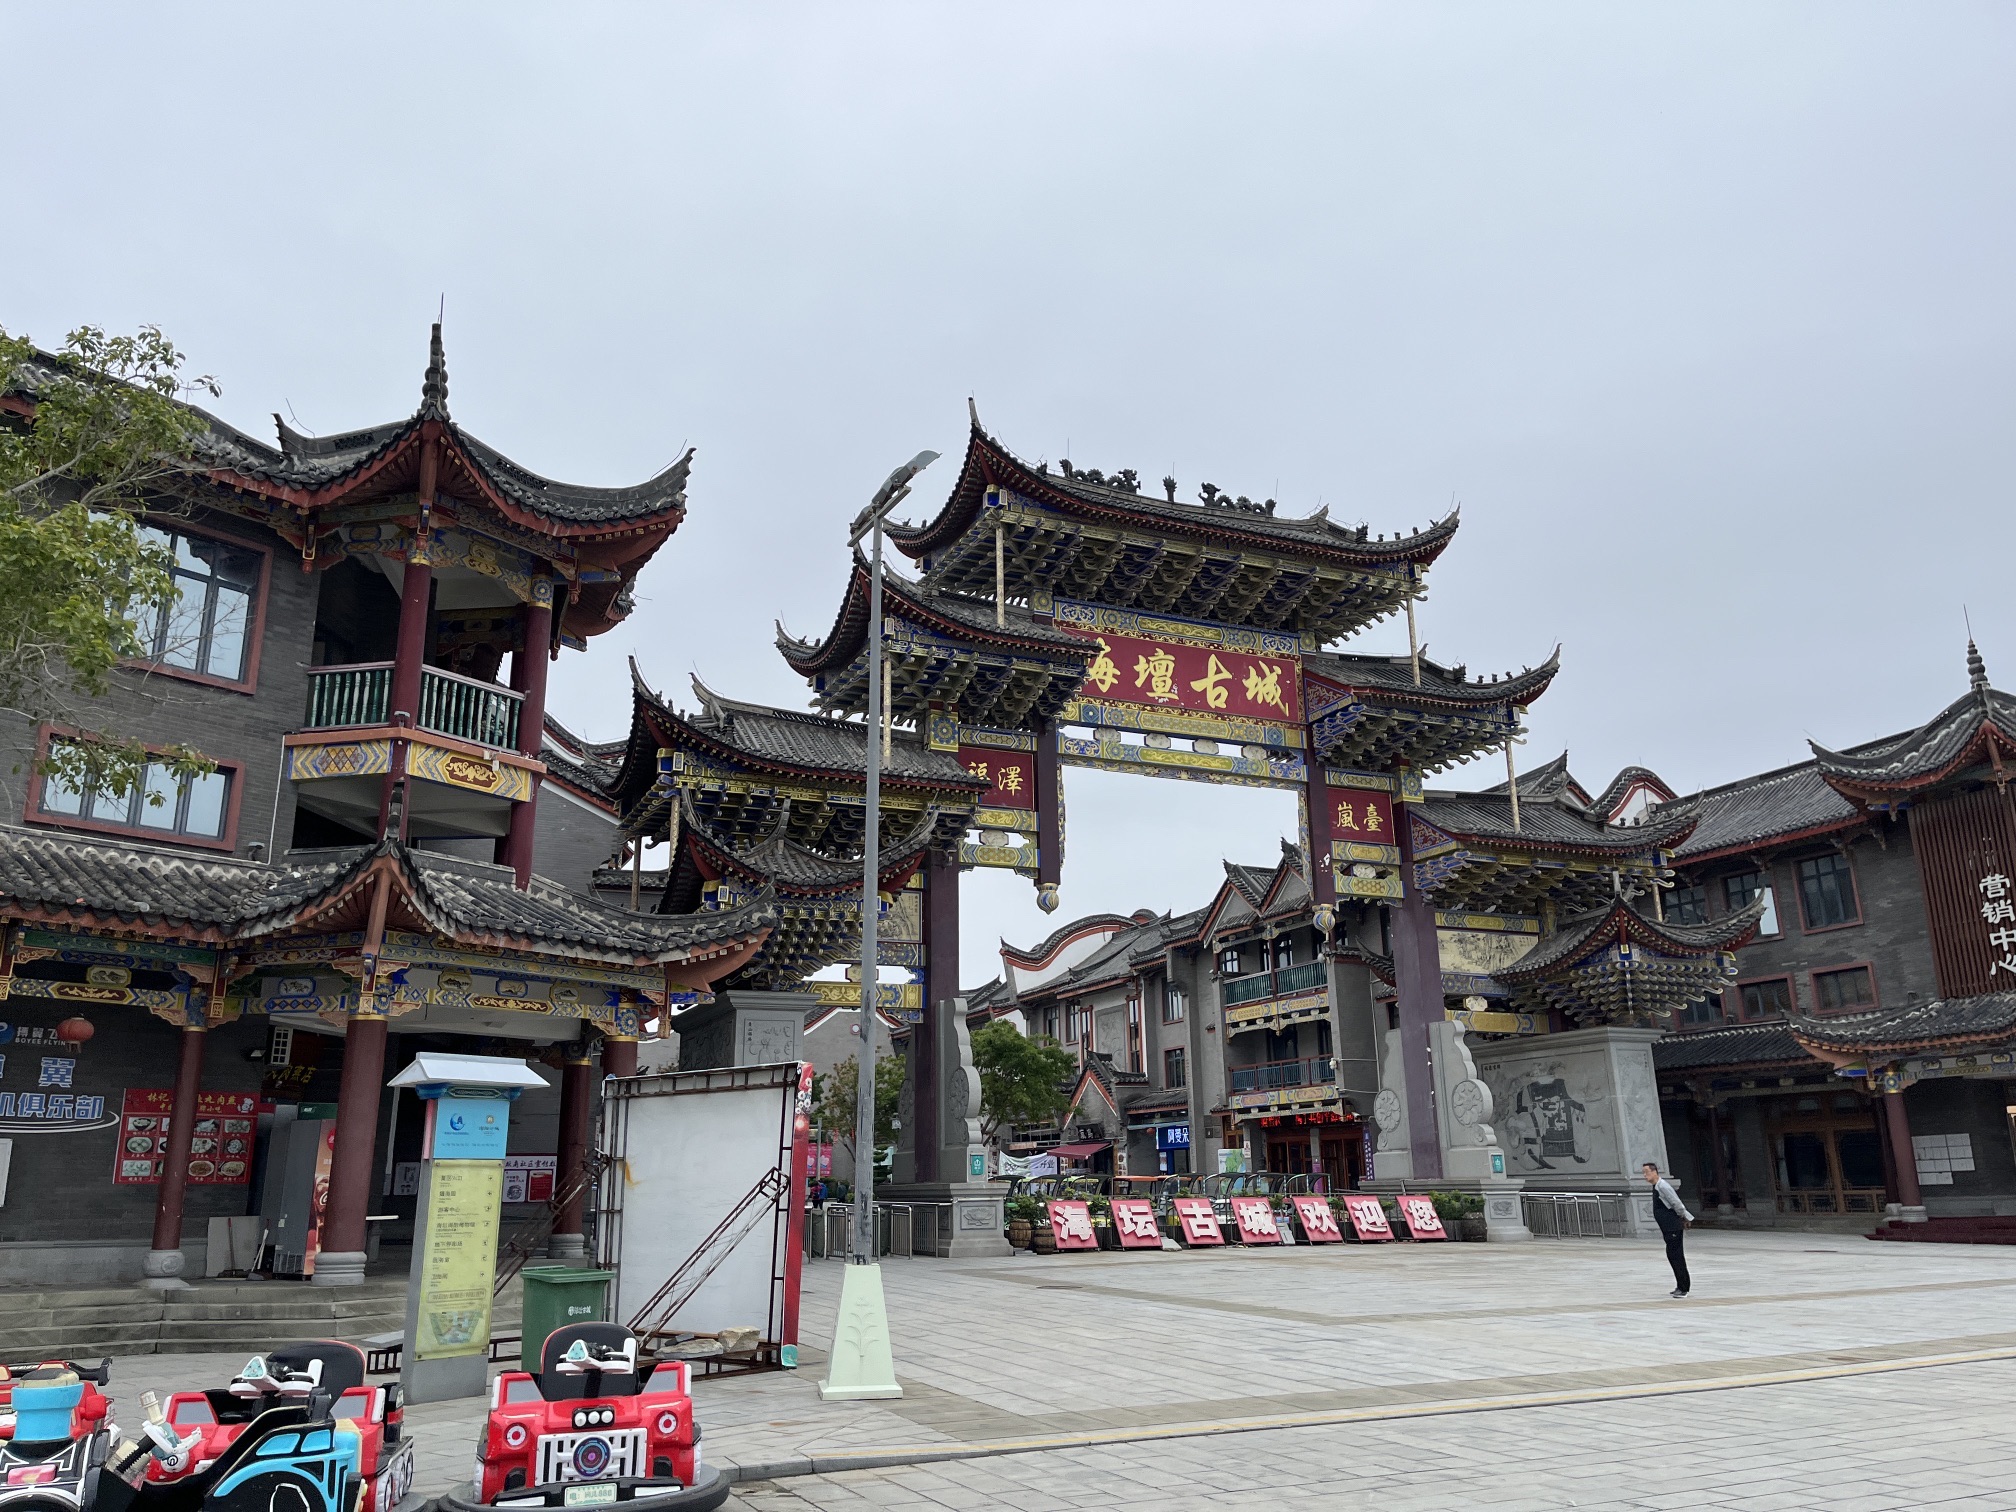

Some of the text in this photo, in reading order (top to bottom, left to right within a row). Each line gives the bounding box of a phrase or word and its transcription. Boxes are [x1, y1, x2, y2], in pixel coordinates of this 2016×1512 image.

[1337, 801, 1384, 832] 嵐臺
[1979, 873, 2016, 977] 营销中心
[15, 1037, 42, 1045] BOYEE
[1053, 1198, 1439, 1242] 海坛古城欢迎您
